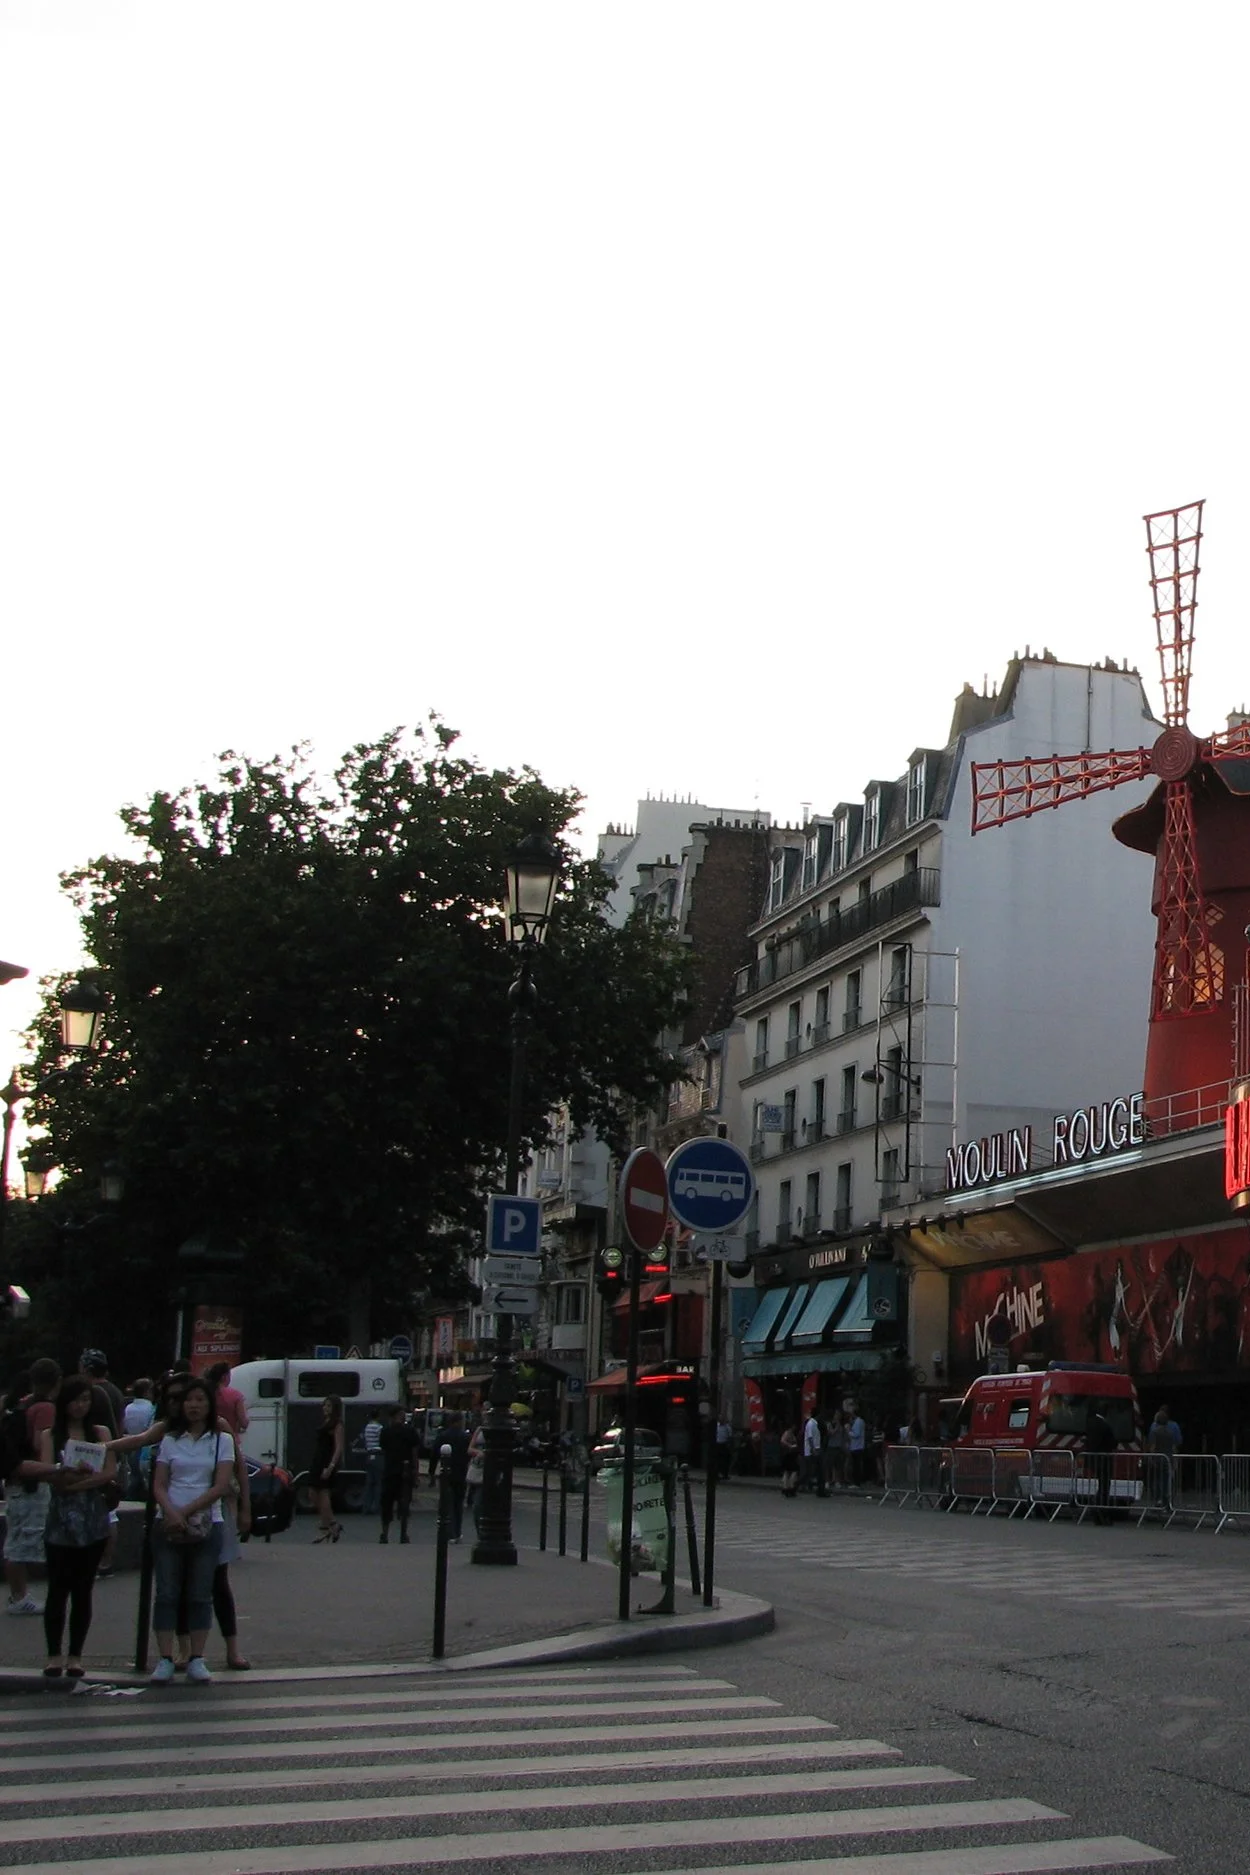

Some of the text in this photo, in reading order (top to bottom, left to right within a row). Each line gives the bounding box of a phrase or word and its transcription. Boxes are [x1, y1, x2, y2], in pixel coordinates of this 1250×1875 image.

[946, 1091, 1145, 1190] MOULIN ROUGE
[503, 1208, 527, 1242] P
[974, 1281, 1045, 1361] MHINE
[676, 1365, 695, 1374] BAR
